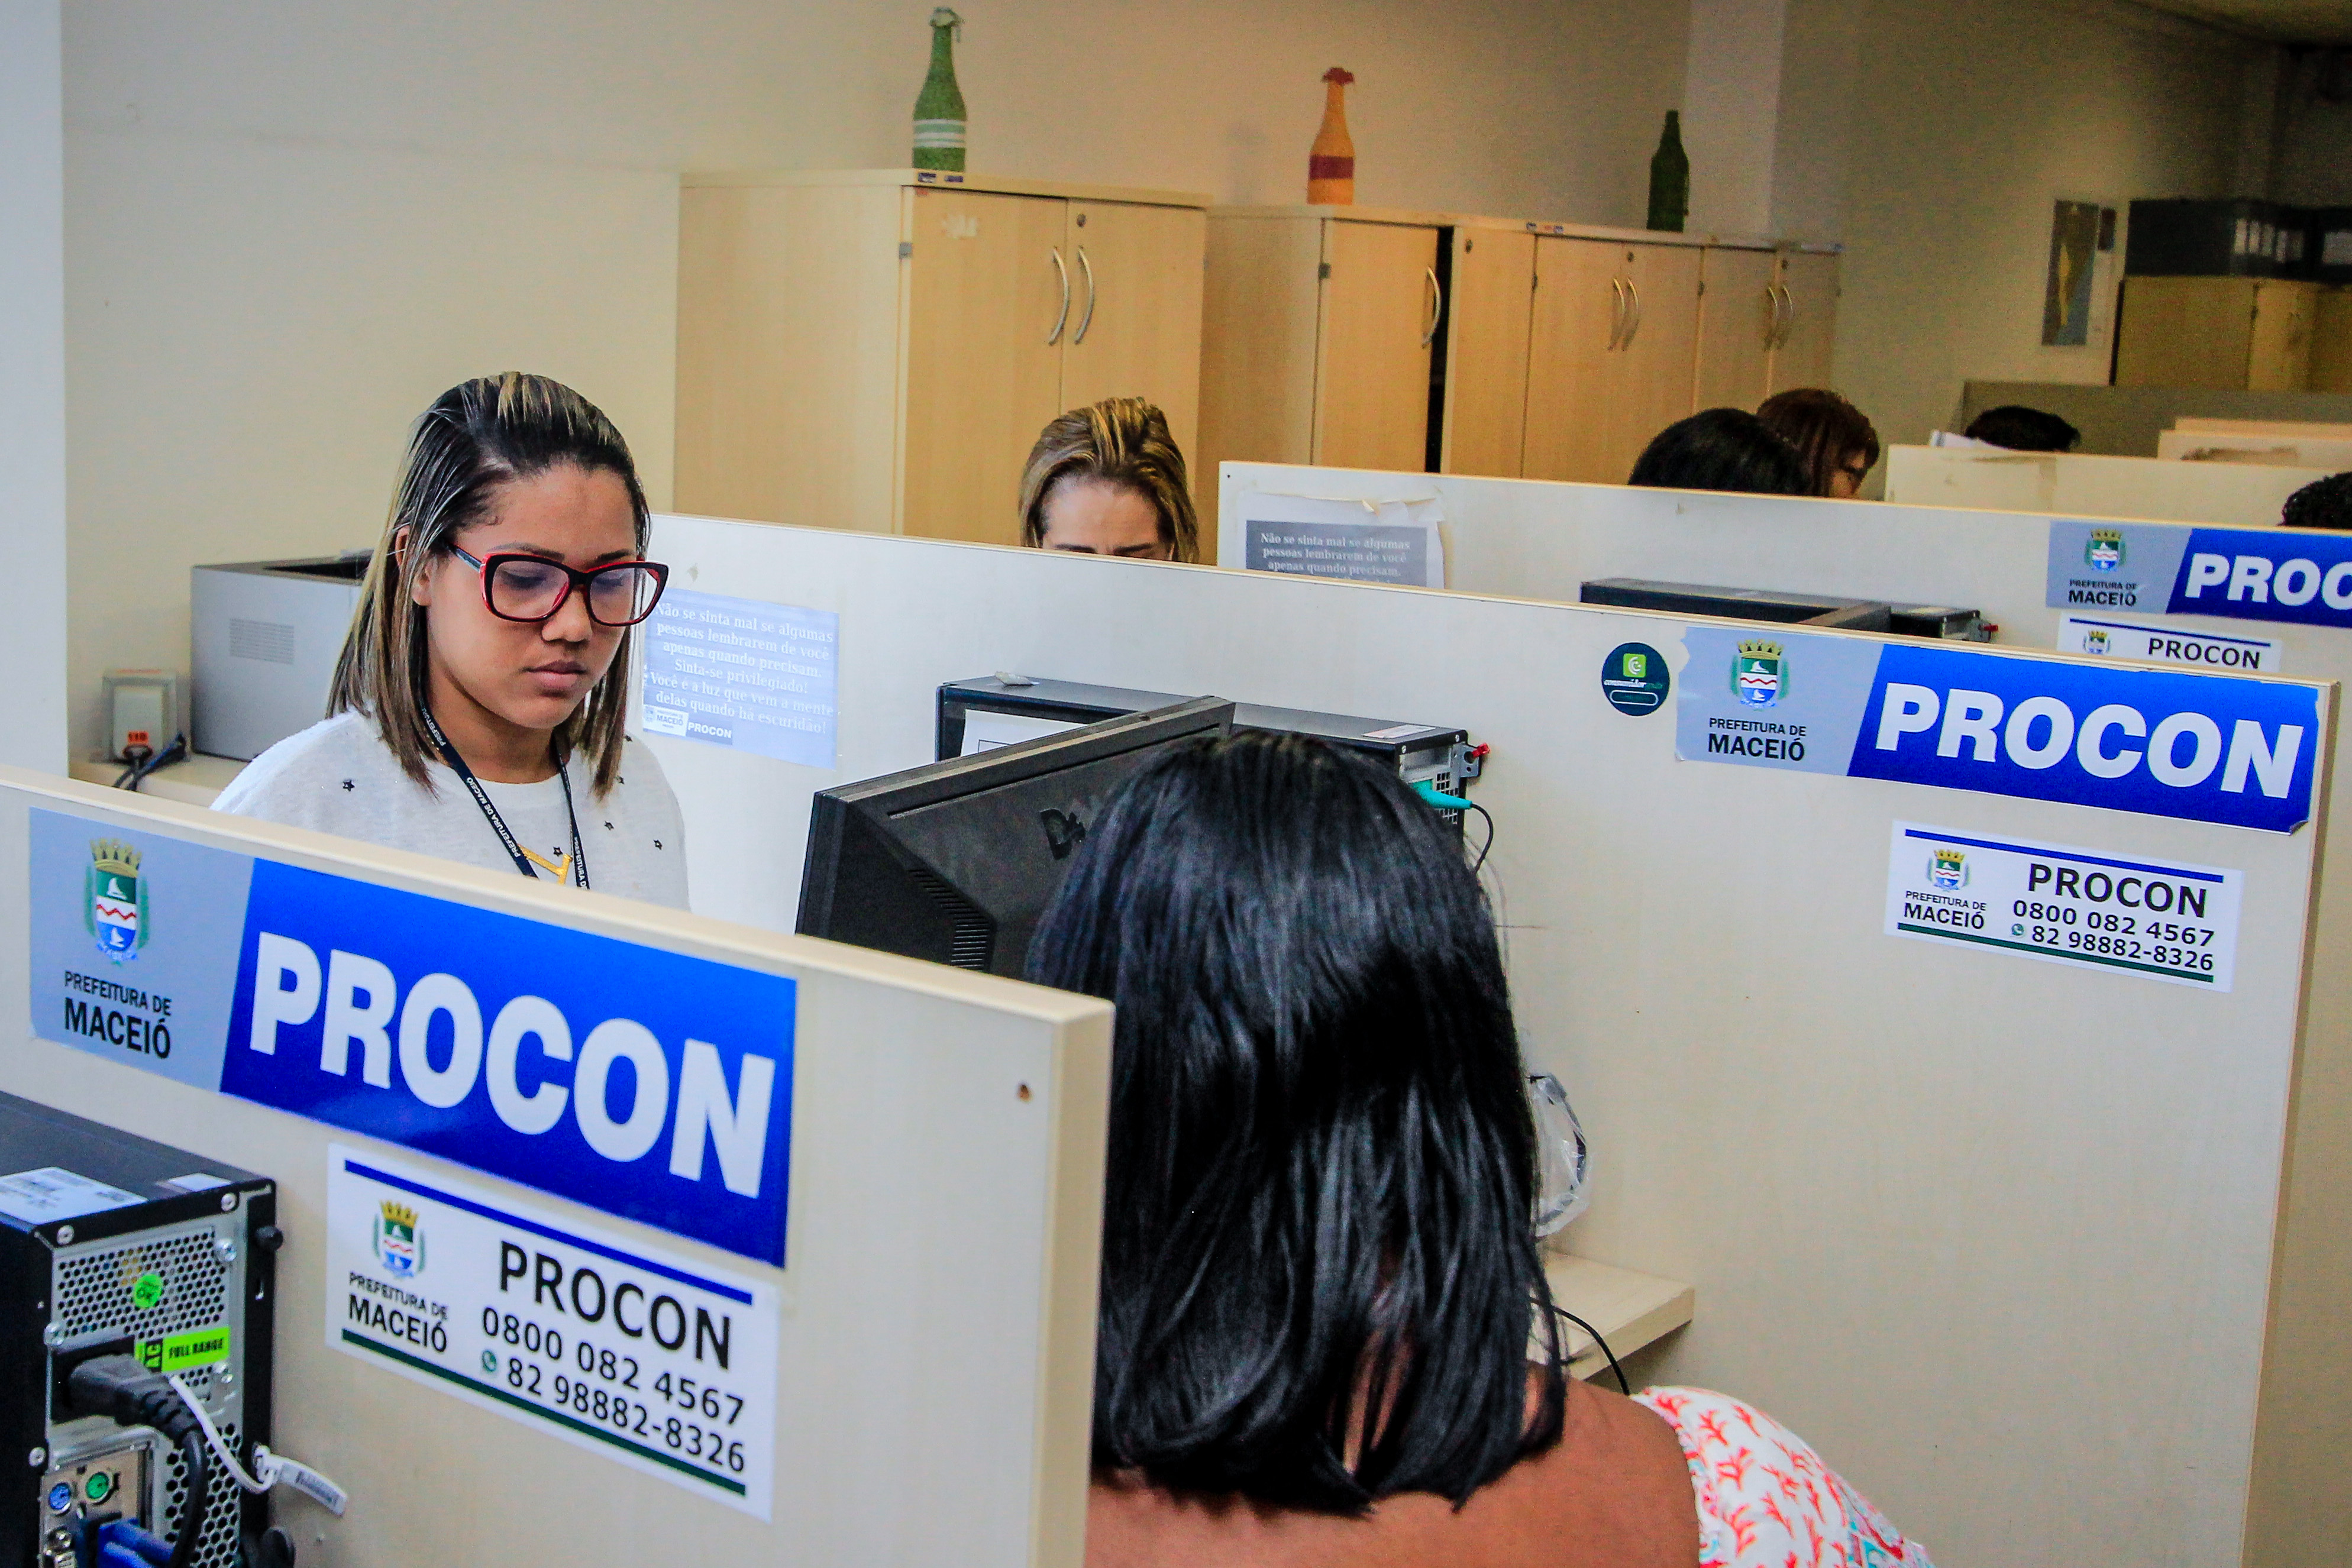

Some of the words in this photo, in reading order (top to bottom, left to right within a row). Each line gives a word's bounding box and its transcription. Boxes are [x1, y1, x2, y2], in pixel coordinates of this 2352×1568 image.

[654, 602, 679, 617] Não
[683, 609, 696, 620] se
[699, 610, 729, 626] sinta
[734, 618, 757, 631] mal
[761, 623, 775, 633] se
[779, 623, 833, 643] algumas
[657, 623, 704, 640] pessoas
[707, 629, 777, 653] lembrarem
[781, 641, 796, 655] de
[800, 646, 829, 661] você
[663, 642, 705, 658] apenas
[708, 650, 755, 667] quando
[759, 659, 822, 678] precisam.
[2149, 638, 2260, 669] PROCON
[650, 671, 678, 689] Você
[692, 683, 699, 692] a
[702, 681, 720, 697] luz
[724, 688, 747, 703] que
[751, 694, 777, 707] vem
[793, 700, 833, 717] mente
[674, 659, 723, 679] Sinta-se
[727, 671, 809, 694] privilegiado!
[656, 691, 687, 707] delas
[690, 700, 735, 717] quando
[758, 713, 826, 734] escuridão!
[688, 722, 732, 738] PROCON
[1710, 717, 1785, 735] PREFEITURA
[1789, 726, 1807, 736] DE
[1708, 733, 1805, 761] MACEIÓ
[1875, 683, 2303, 800] PROCON
[467, 777, 487, 804] MACEIÓ
[484, 804, 494, 815] DE
[492, 814, 521, 858] PREFEITURA
[1905, 891, 1969, 909] PREFEITURA
[1973, 901, 1986, 911] DE
[2028, 863, 2207, 919] PROCON
[1904, 903, 1985, 930] MACEIÓ
[2013, 900, 2076, 925] 0800
[2088, 911, 2135, 935] 082
[2146, 921, 2214, 947] 4567
[2033, 926, 2059, 946] 82
[2069, 932, 2214, 971] 98882-8326
[64, 971, 148, 1011] PREFEITURA
[153, 995, 172, 1017] DE
[64, 997, 172, 1059] MACEIÓ
[250, 931, 776, 1198] PROCON
[349, 1272, 426, 1315] PREFEITURA
[430, 1301, 448, 1321] DE
[500, 1241, 732, 1370] PROCON
[348, 1295, 447, 1354] MACEIÓ
[483, 1307, 563, 1359] 0800
[577, 1341, 639, 1390] 082
[655, 1372, 744, 1426] 4567
[508, 1358, 542, 1397] 82
[555, 1376, 744, 1473] 98882-8326
